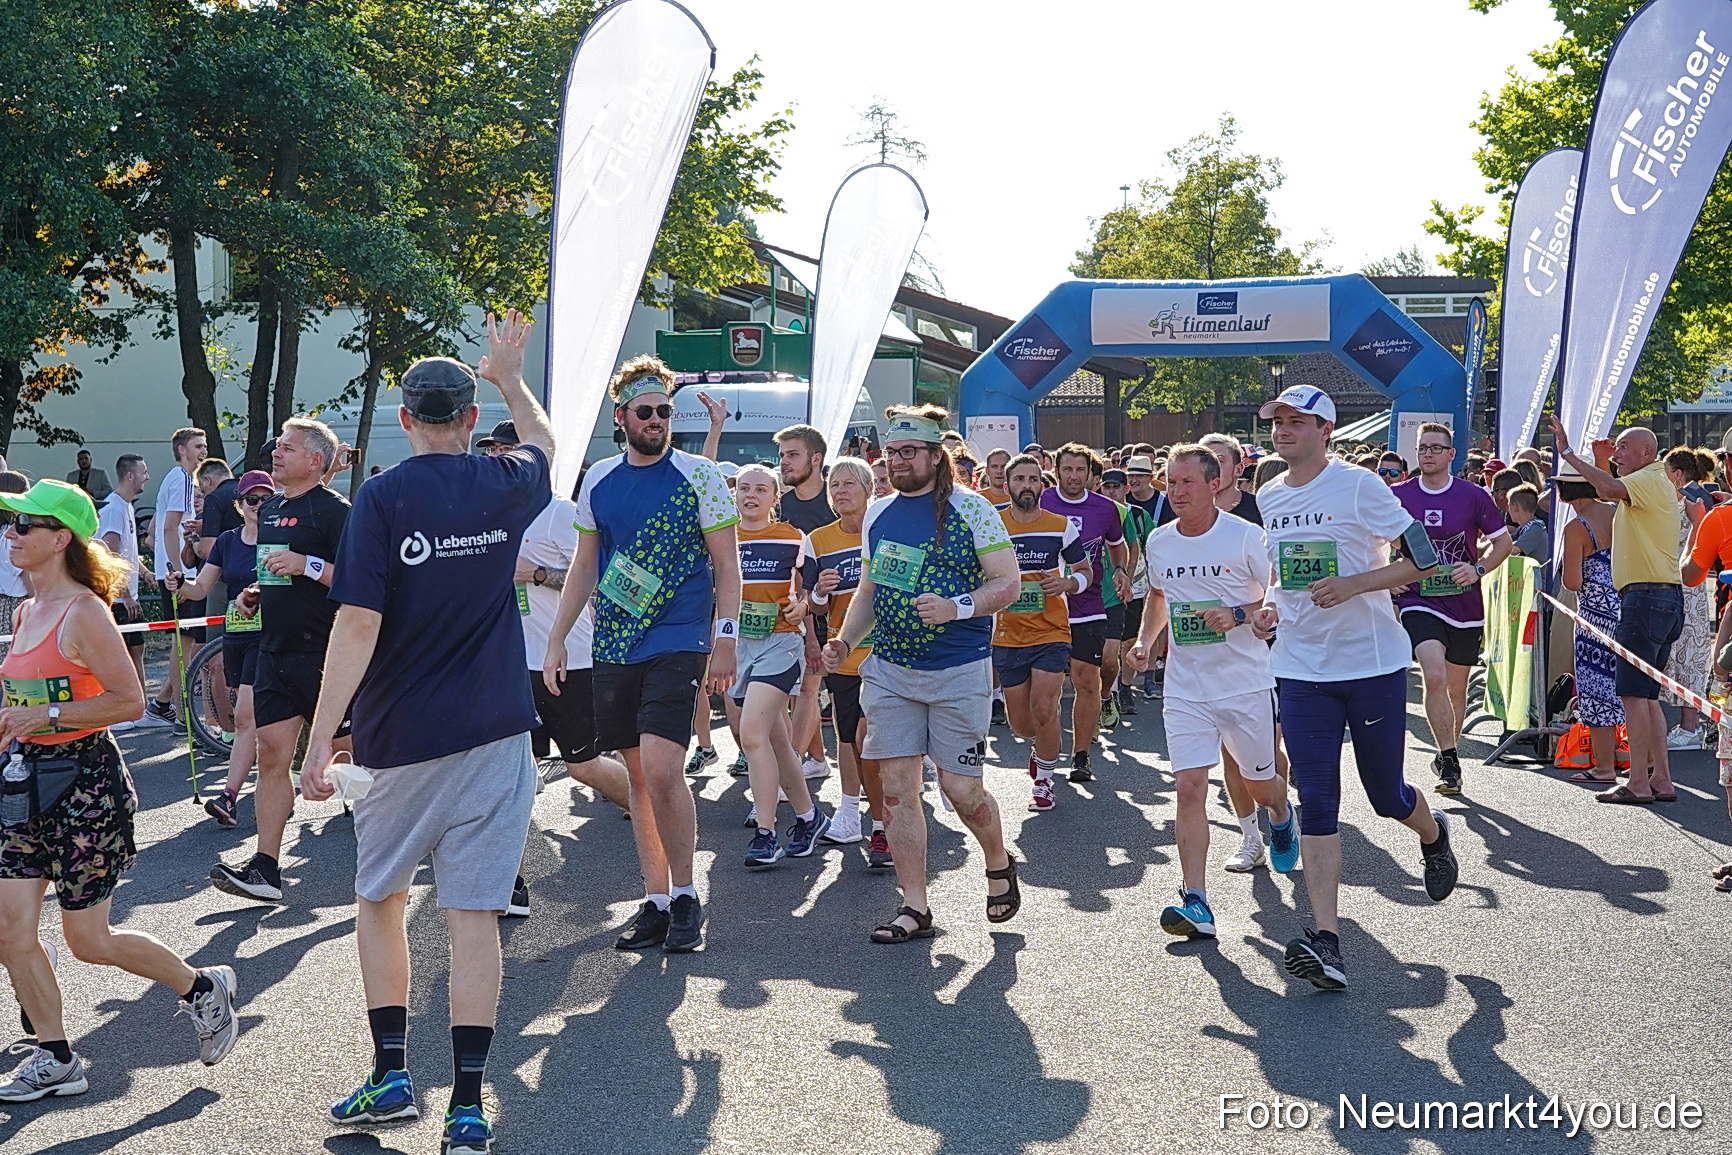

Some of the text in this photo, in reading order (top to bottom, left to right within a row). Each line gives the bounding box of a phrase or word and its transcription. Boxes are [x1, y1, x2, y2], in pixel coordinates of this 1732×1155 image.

[1632, 30, 1714, 185] Fischer
[1669, 52, 1730, 178] AUTOMOBILE
[1537, 175, 1577, 277] Fischer
[1205, 299, 1235, 307] Fischer
[1183, 314, 1271, 332] firmenlauf
[1013, 346, 1060, 356] Fischer
[1271, 513, 1324, 530] APTIV
[434, 529, 508, 550] Lebenshilfe
[435, 546, 489, 558] Neumarkt e.V.
[843, 567, 861, 577] Fis
[881, 556, 908, 575] 693
[1166, 566, 1222, 579] APTIV
[1292, 558, 1323, 575] 234
[1328, 561, 1336, 577] 022
[908, 566, 919, 586] 2022
[614, 573, 642, 598] 694
[637, 592, 652, 612] 2022
[739, 614, 769, 627] 1831
[1181, 616, 1207, 632] 857
